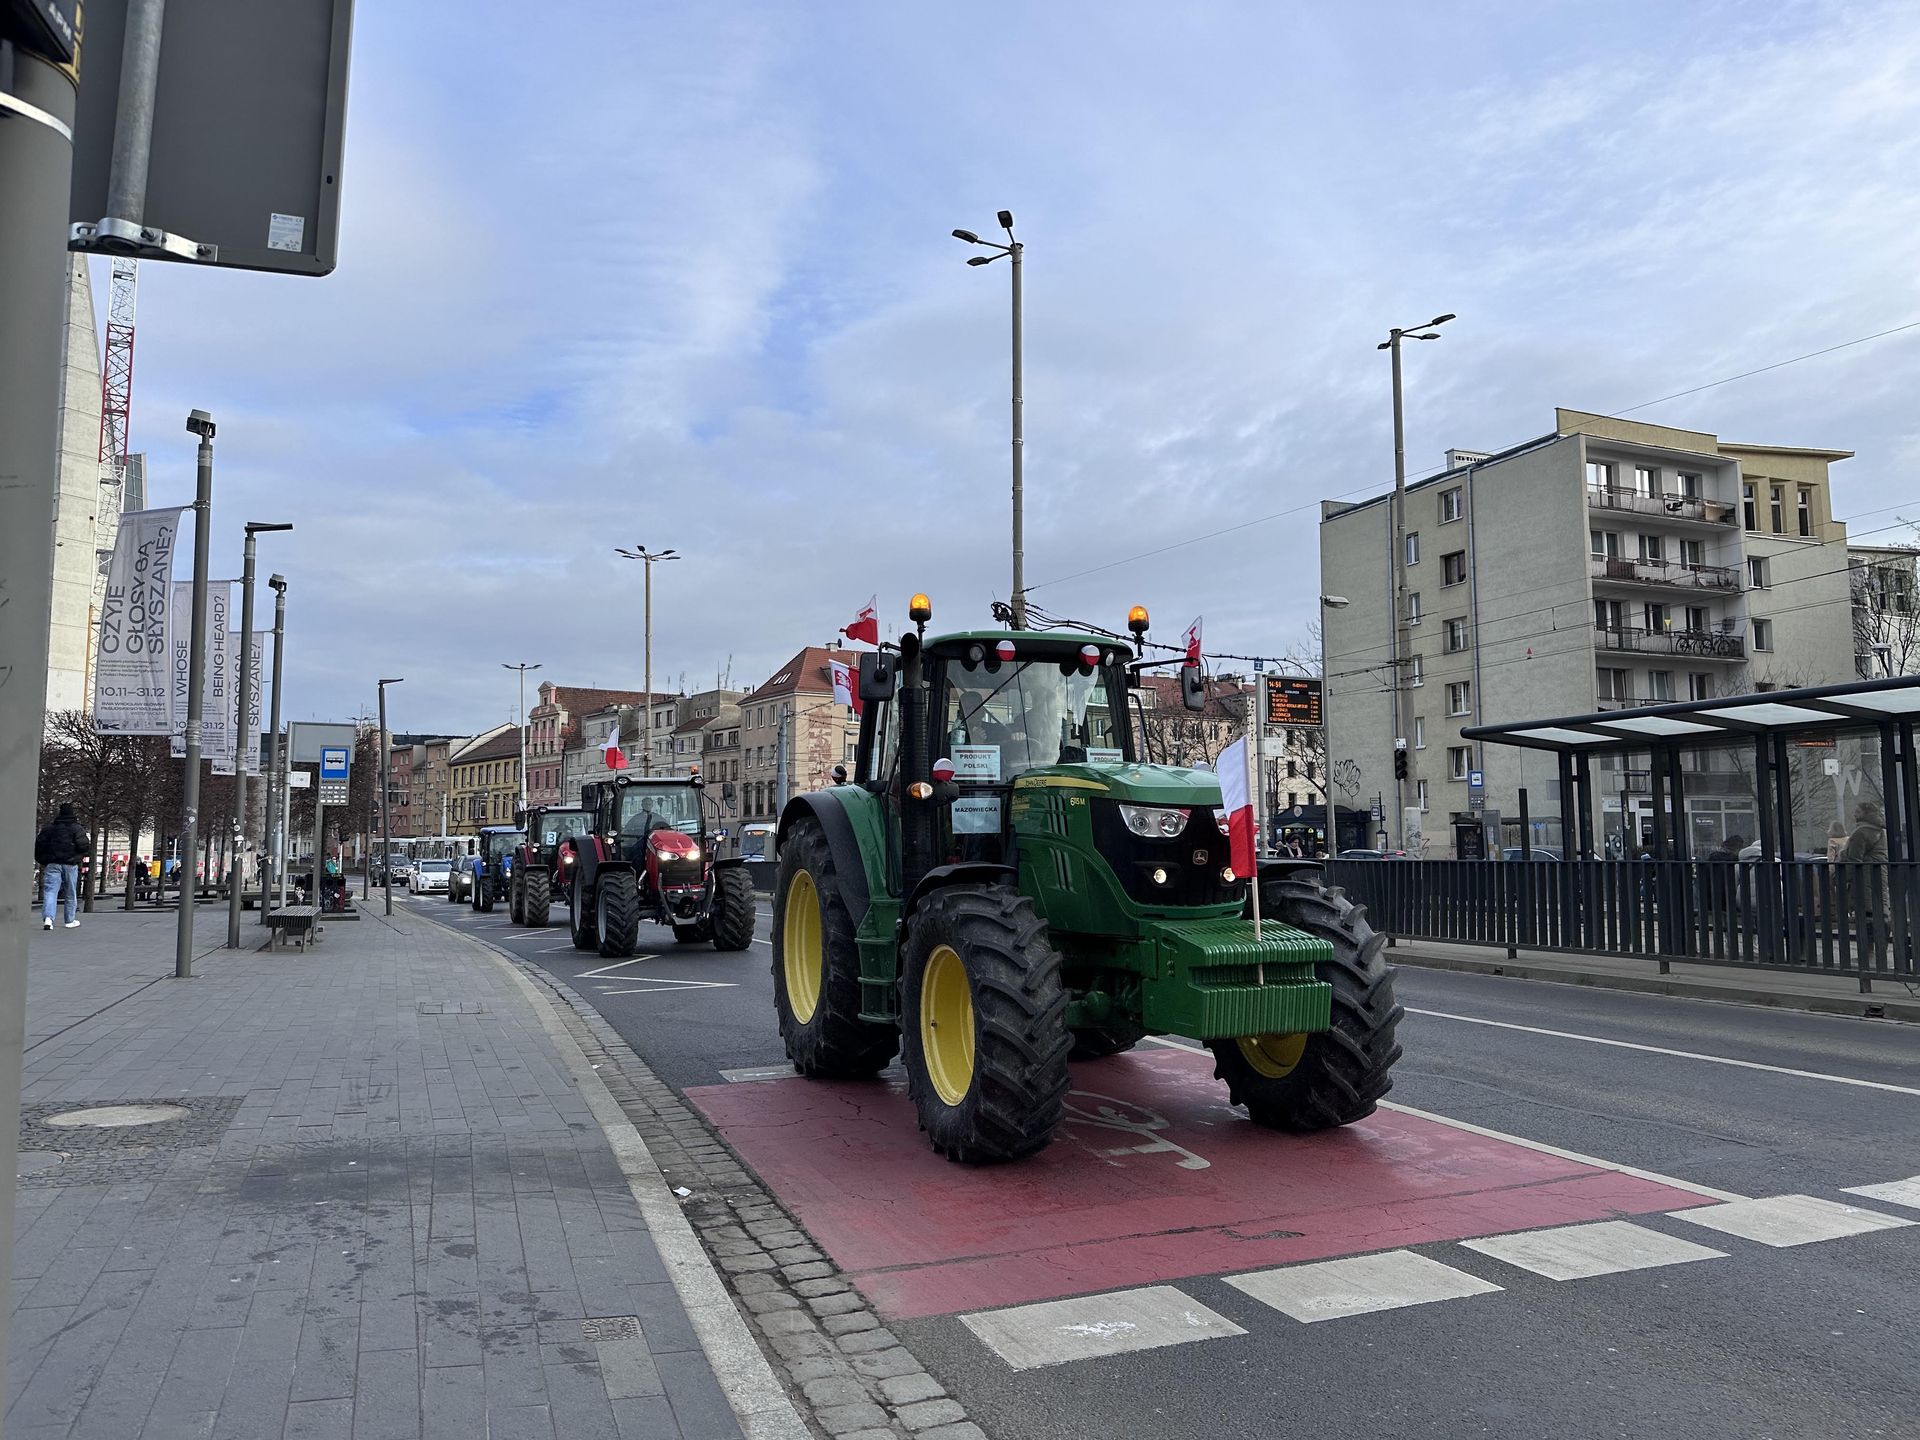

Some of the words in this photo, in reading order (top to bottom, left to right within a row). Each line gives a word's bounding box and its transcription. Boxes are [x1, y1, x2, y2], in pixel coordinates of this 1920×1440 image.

[135, 540, 156, 573] SĄ
[126, 576, 146, 654] GŁOSY
[148, 526, 173, 654] SŁYSZANE?
[102, 586, 125, 654] CZYJE
[213, 595, 225, 652] HEARD?
[176, 640, 188, 697] WHOSE
[213, 653, 225, 697] BEING
[547, 833, 555, 843] 3
